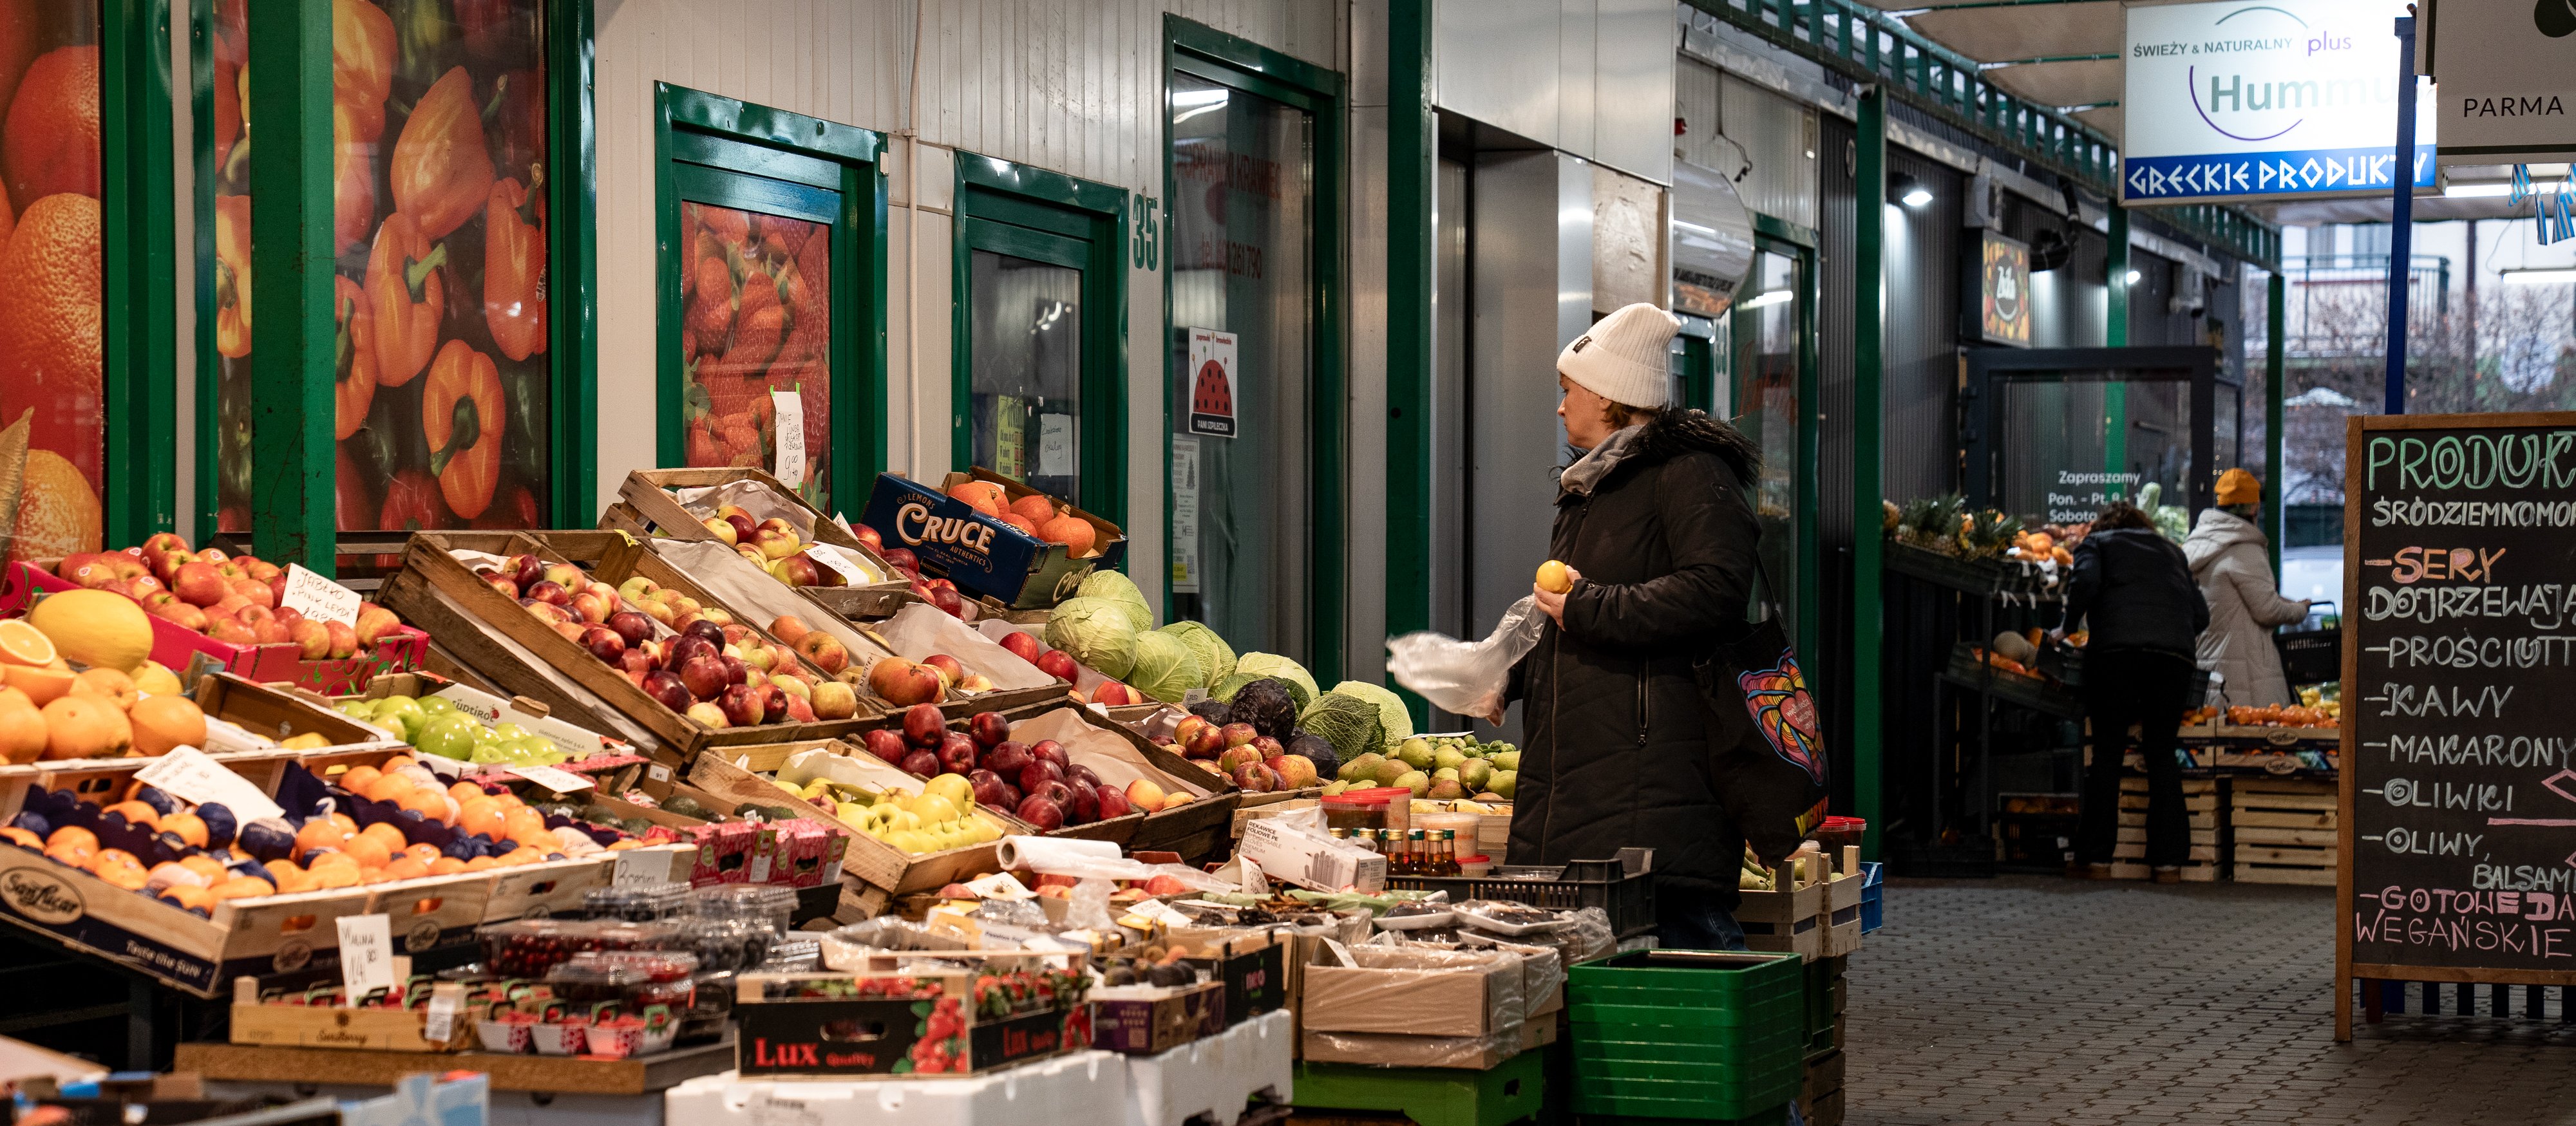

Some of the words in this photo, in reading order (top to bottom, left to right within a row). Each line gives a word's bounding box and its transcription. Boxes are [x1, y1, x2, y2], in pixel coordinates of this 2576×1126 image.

[2134, 42, 2188, 57] ŚWIEŻY
[2192, 44, 2199, 54] &
[2204, 37, 2293, 53] NATURALNY
[2307, 31, 2352, 57] plus
[2463, 96, 2564, 118] PARMA
[2128, 160, 2250, 194] GRECKIE
[2259, 152, 2428, 190] PRODUKY
[1133, 194, 1157, 271] 35
[1197, 420, 1208, 429] PANI
[2058, 471, 2141, 486] Zapraszamy
[907, 493, 936, 510] LEMONS
[2048, 493, 2077, 505] Pon.
[2049, 509, 2098, 523] Sobota
[896, 503, 996, 555] CRUCE
[949, 545, 986, 567] AUTHENTICS
[1248, 821, 1276, 835] RĘKAWICE
[2356, 908, 2572, 959] WEGAŃSKIE
[155, 952, 177, 970] the
[755, 1037, 819, 1067] Lux
